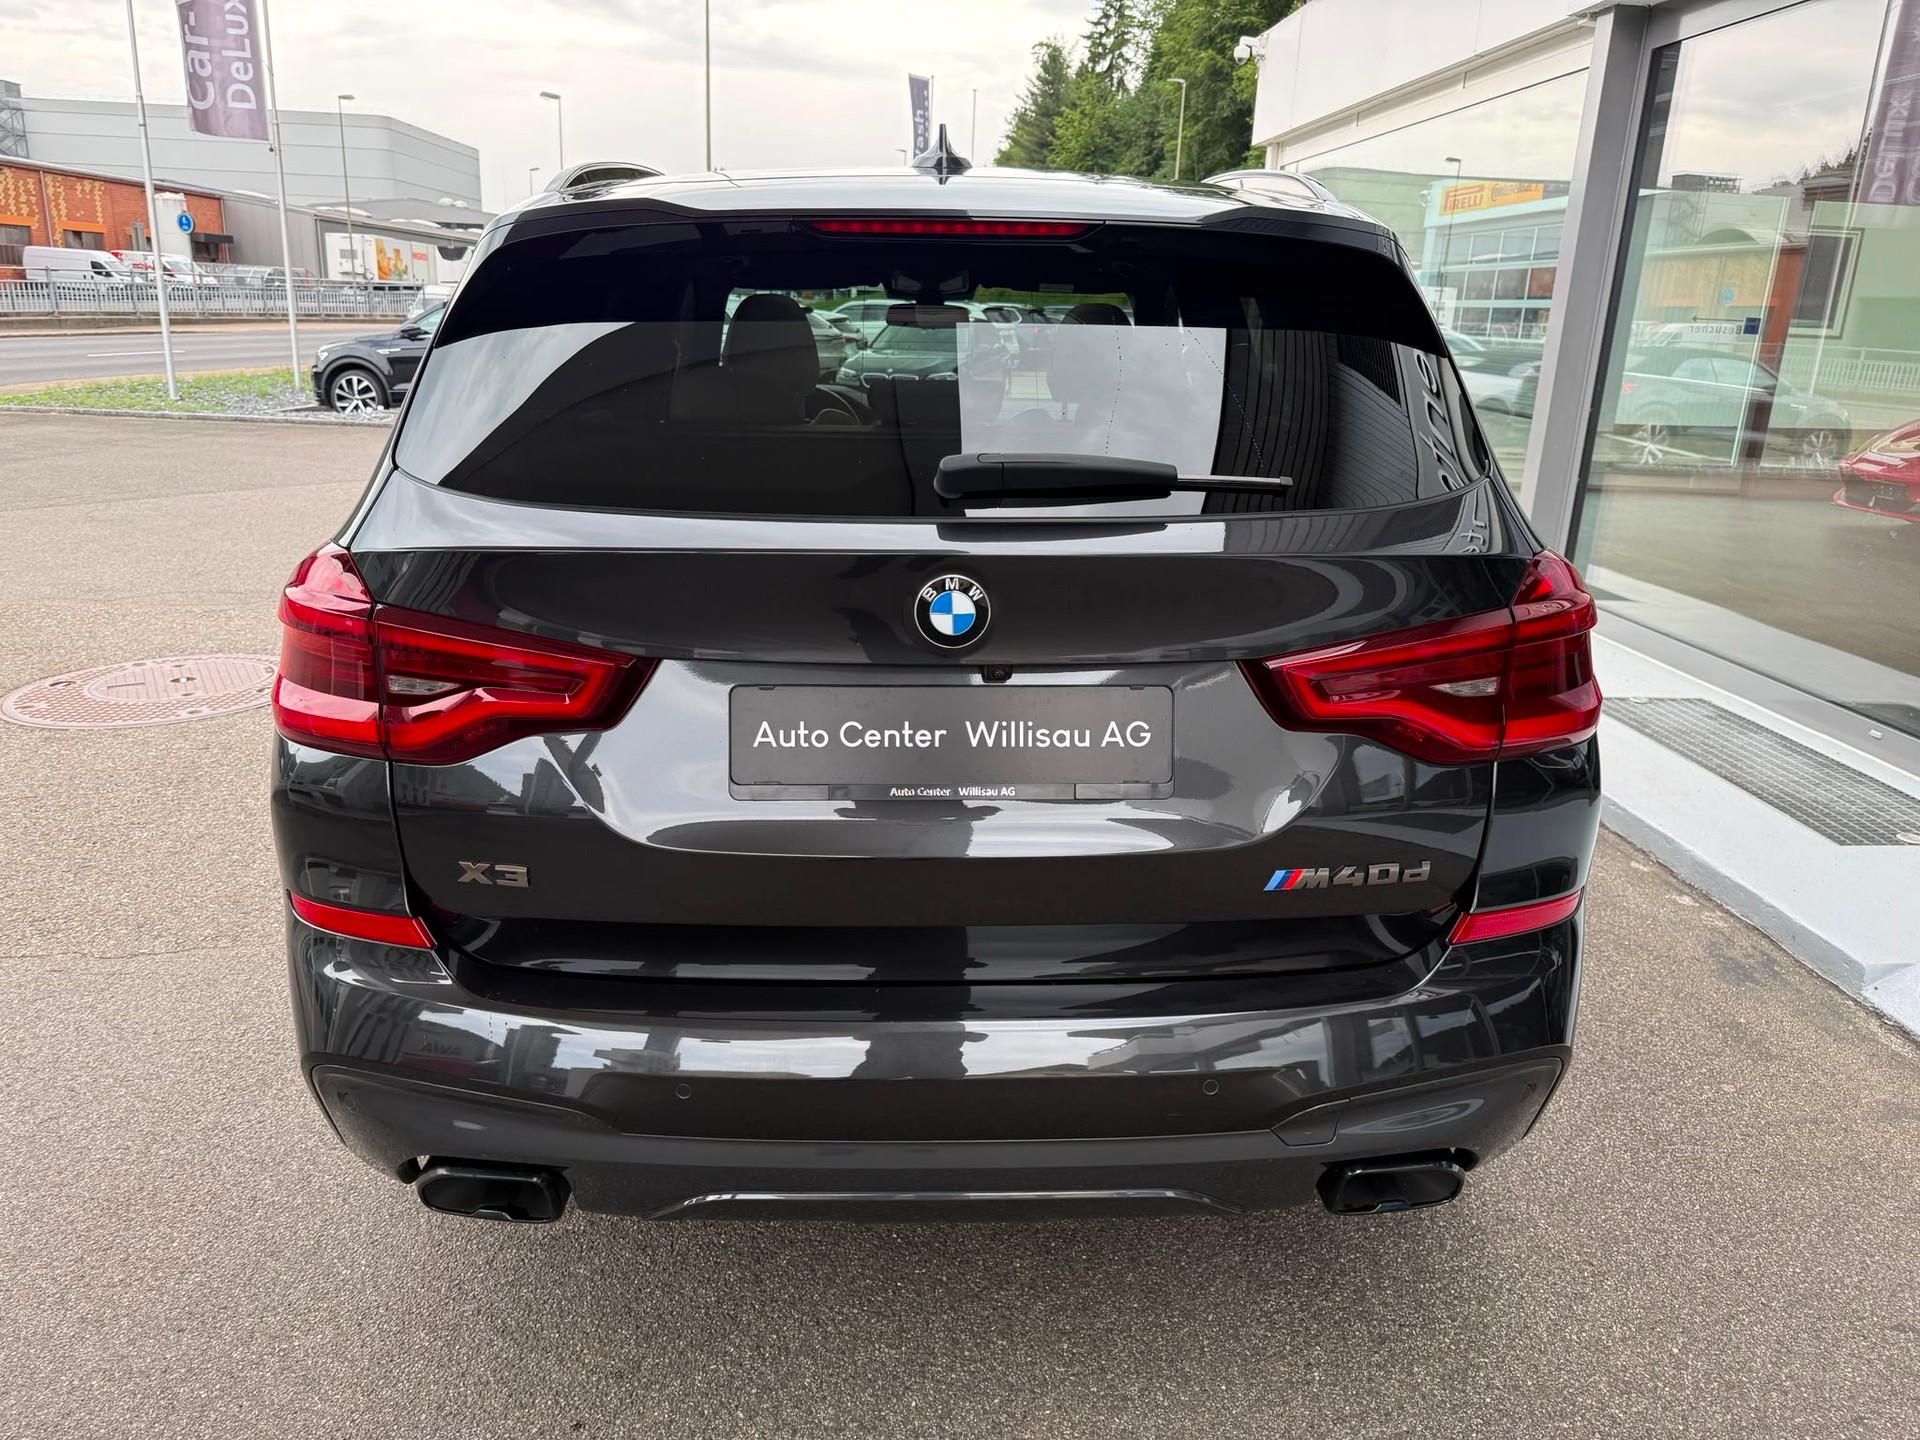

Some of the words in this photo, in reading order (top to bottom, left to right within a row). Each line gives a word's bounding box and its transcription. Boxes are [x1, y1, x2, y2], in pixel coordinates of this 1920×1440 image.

[184, 11, 215, 111] Car-
[1443, 184, 1486, 212] PIRELLI
[922, 577, 984, 602] BMW
[752, 720, 829, 748] Auto
[839, 720, 947, 748] Center
[965, 720, 1091, 748] Willisau
[1100, 720, 1152, 748] AG
[889, 787, 915, 797] Auto
[917, 787, 951, 797] Center
[958, 786, 998, 797] Willisau
[1000, 786, 1016, 797] AG
[457, 861, 529, 888] X3
[1290, 860, 1431, 889] M40d
